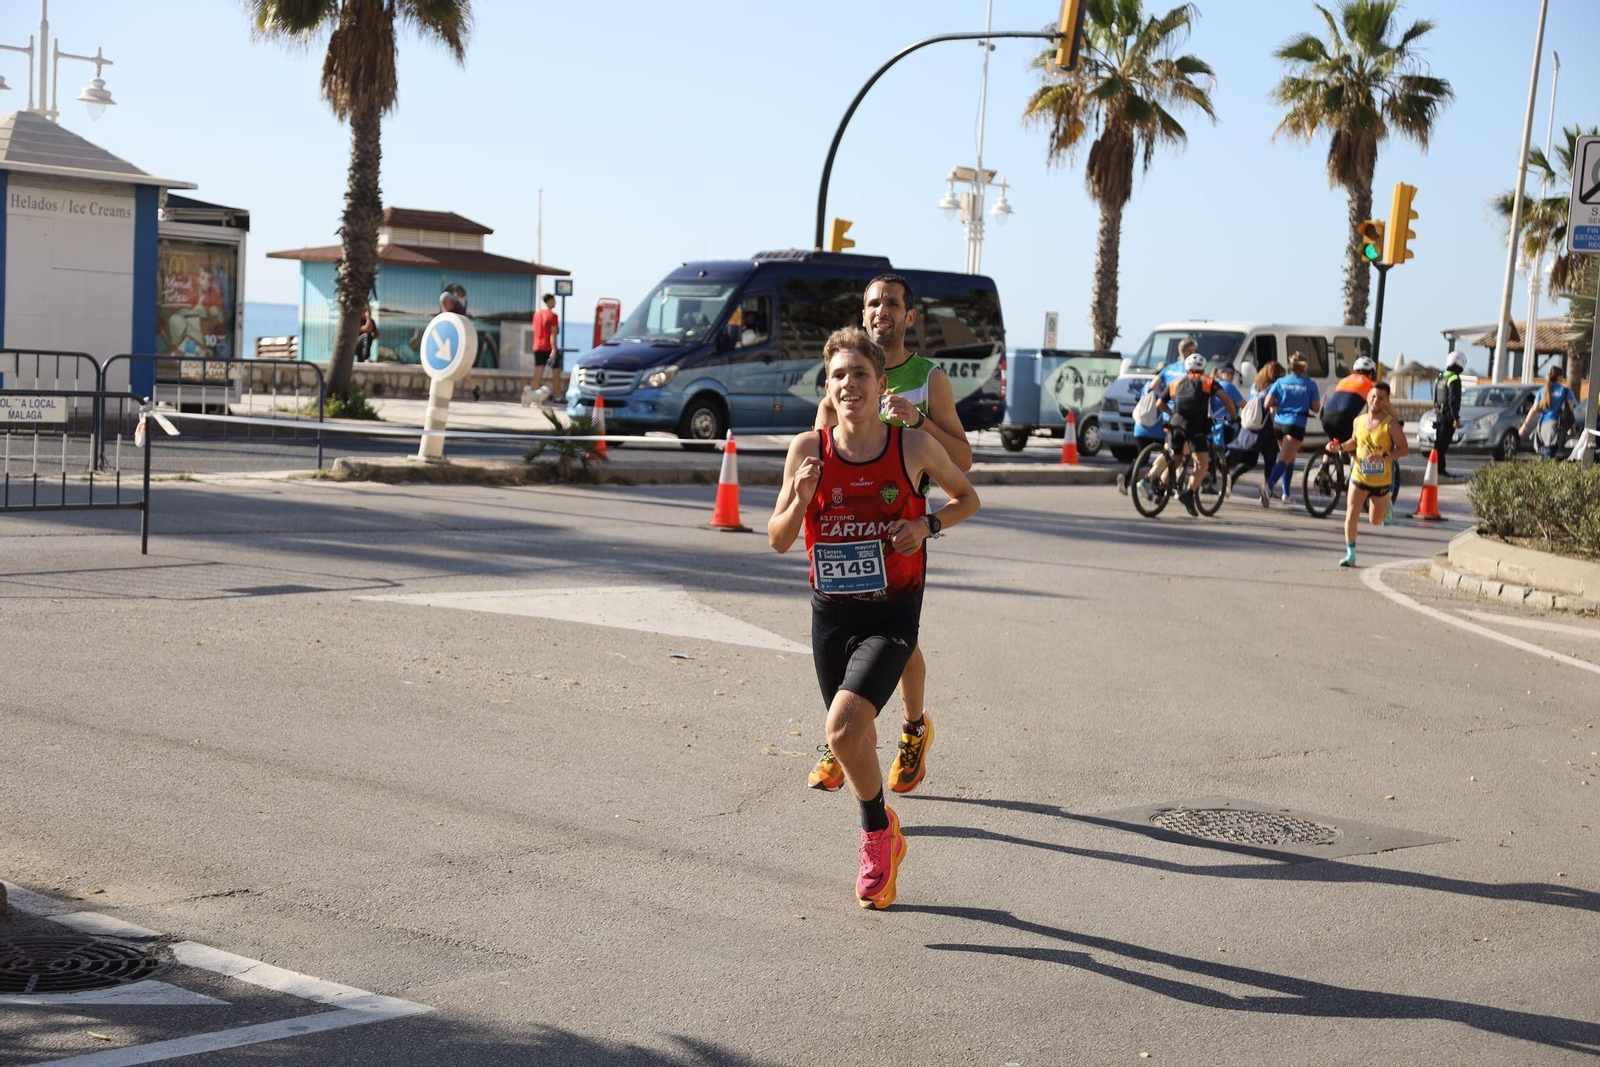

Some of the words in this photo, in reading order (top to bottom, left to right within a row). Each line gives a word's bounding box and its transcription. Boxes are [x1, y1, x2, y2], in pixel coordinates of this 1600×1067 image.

[10, 193, 58, 212] Helados
[69, 199, 86, 214] Ice
[89, 201, 132, 219] Creams
[1586, 226, 1599, 235] FIN
[29, 399, 56, 409] LOCAL
[8, 410, 42, 420] MALAGA
[854, 543, 877, 551] mayoral
[821, 559, 876, 577] 2149
